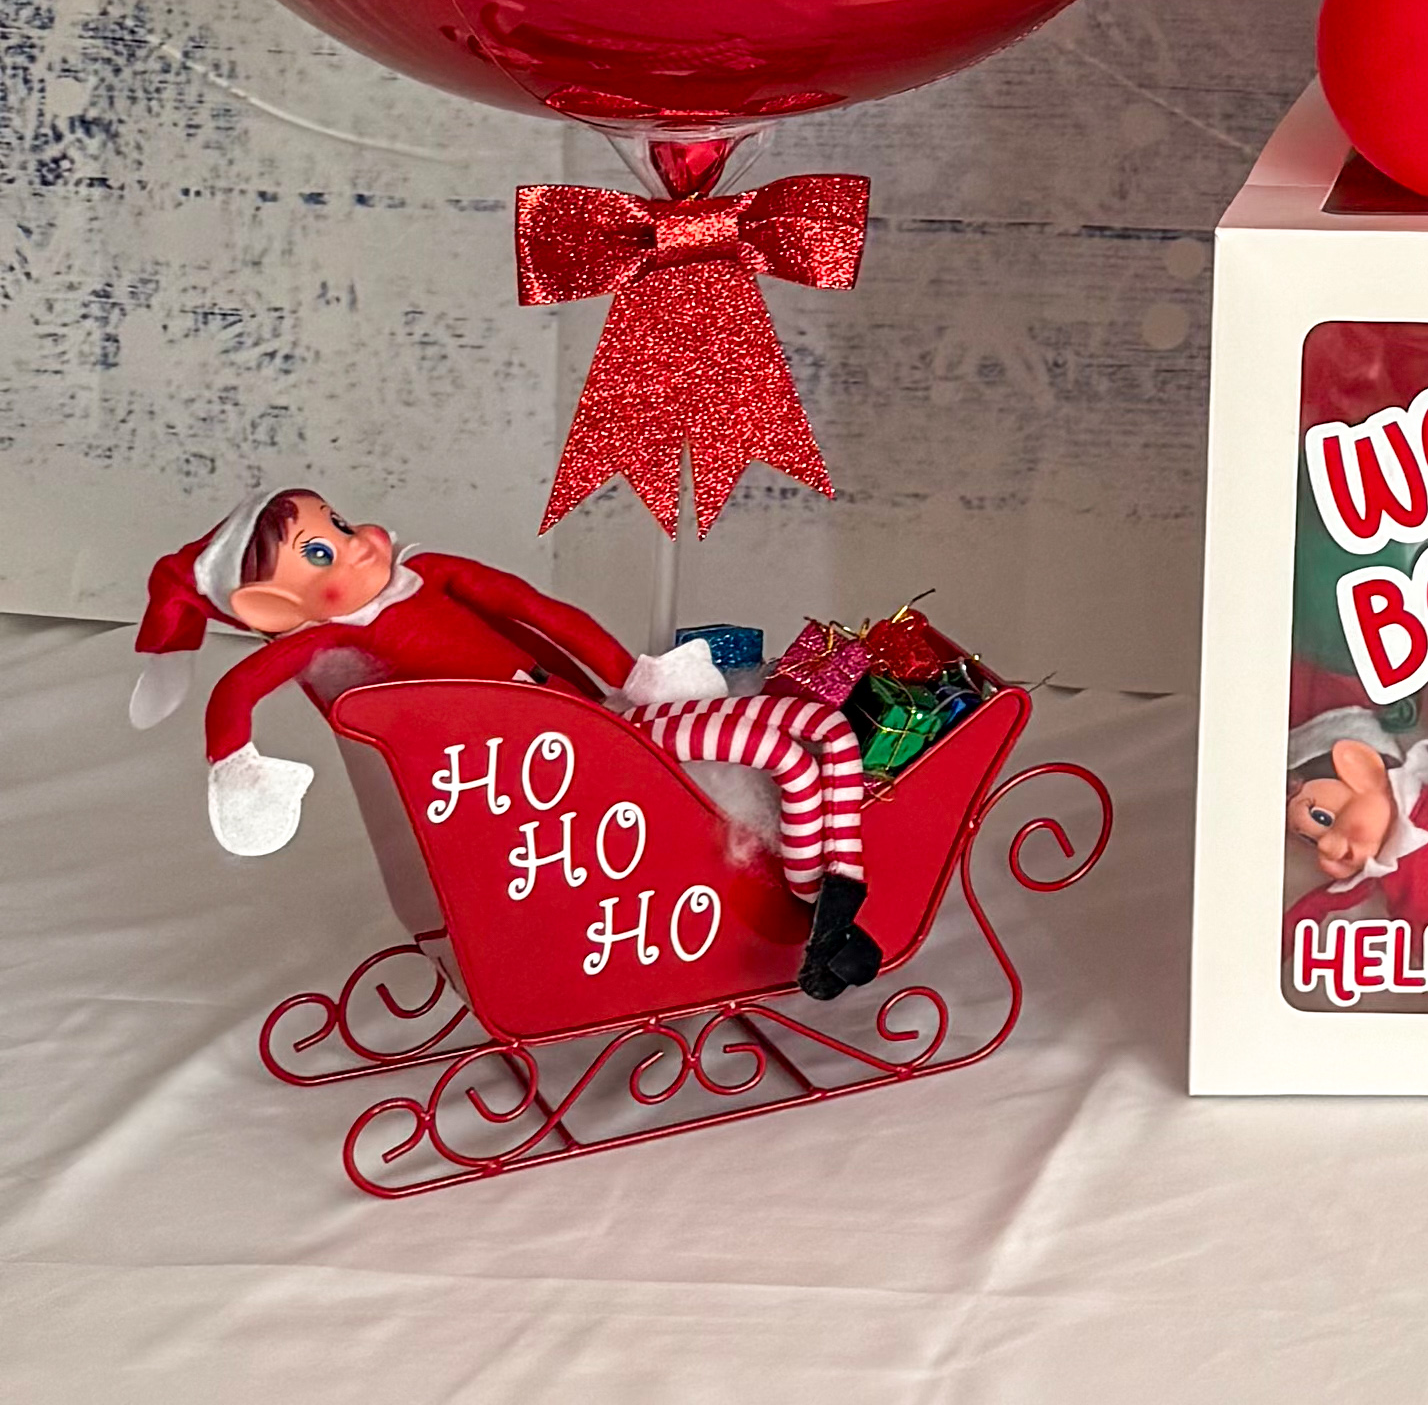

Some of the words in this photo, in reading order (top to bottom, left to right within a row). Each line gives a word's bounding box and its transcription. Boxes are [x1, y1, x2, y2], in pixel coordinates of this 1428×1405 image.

[427, 732, 575, 823] HO
[507, 802, 646, 900] HO
[583, 885, 721, 975] HO
